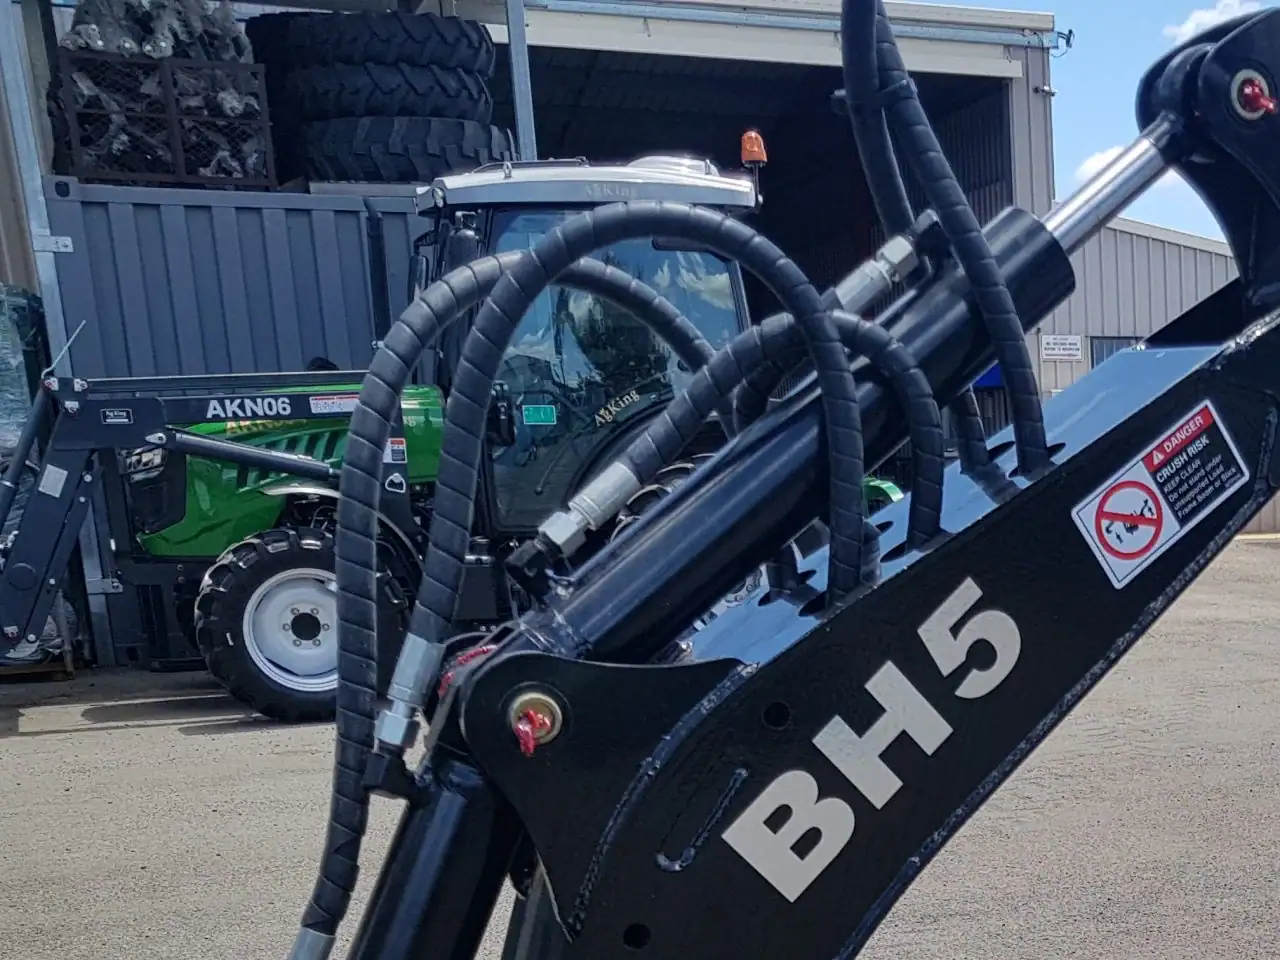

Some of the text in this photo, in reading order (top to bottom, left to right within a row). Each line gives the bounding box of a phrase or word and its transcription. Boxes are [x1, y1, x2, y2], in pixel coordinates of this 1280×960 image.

[206, 397, 292, 418] AKN06
[594, 389, 640, 427] AgKing
[1163, 415, 1204, 453] DANGER
[1156, 434, 1210, 483] CRUSH RISK
[1163, 459, 1202, 494] KEEP CLEAR
[721, 576, 1021, 903] BH5
